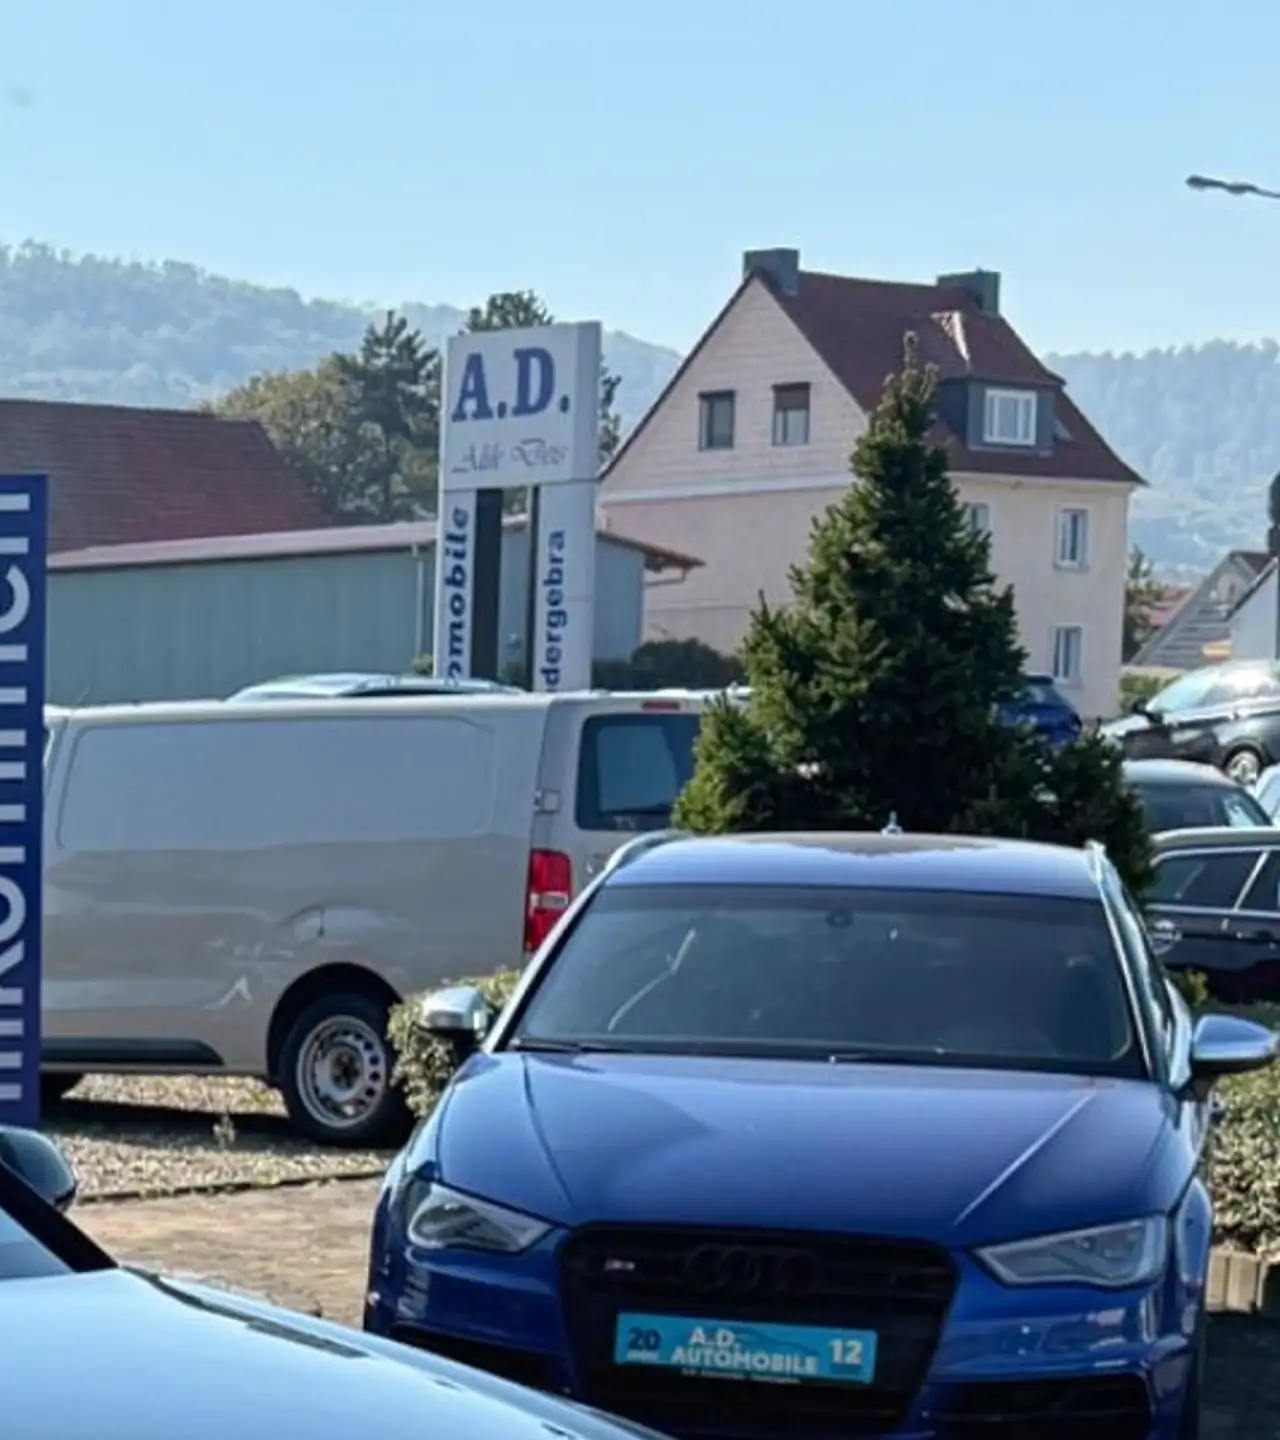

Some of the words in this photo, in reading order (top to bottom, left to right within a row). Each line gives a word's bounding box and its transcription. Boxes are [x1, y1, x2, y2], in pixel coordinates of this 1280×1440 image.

[451, 347, 569, 422] A.D.
[628, 1327, 661, 1350] 20
[829, 1338, 863, 1364] 12
[670, 1345, 819, 1374] AUTOMOBILE
